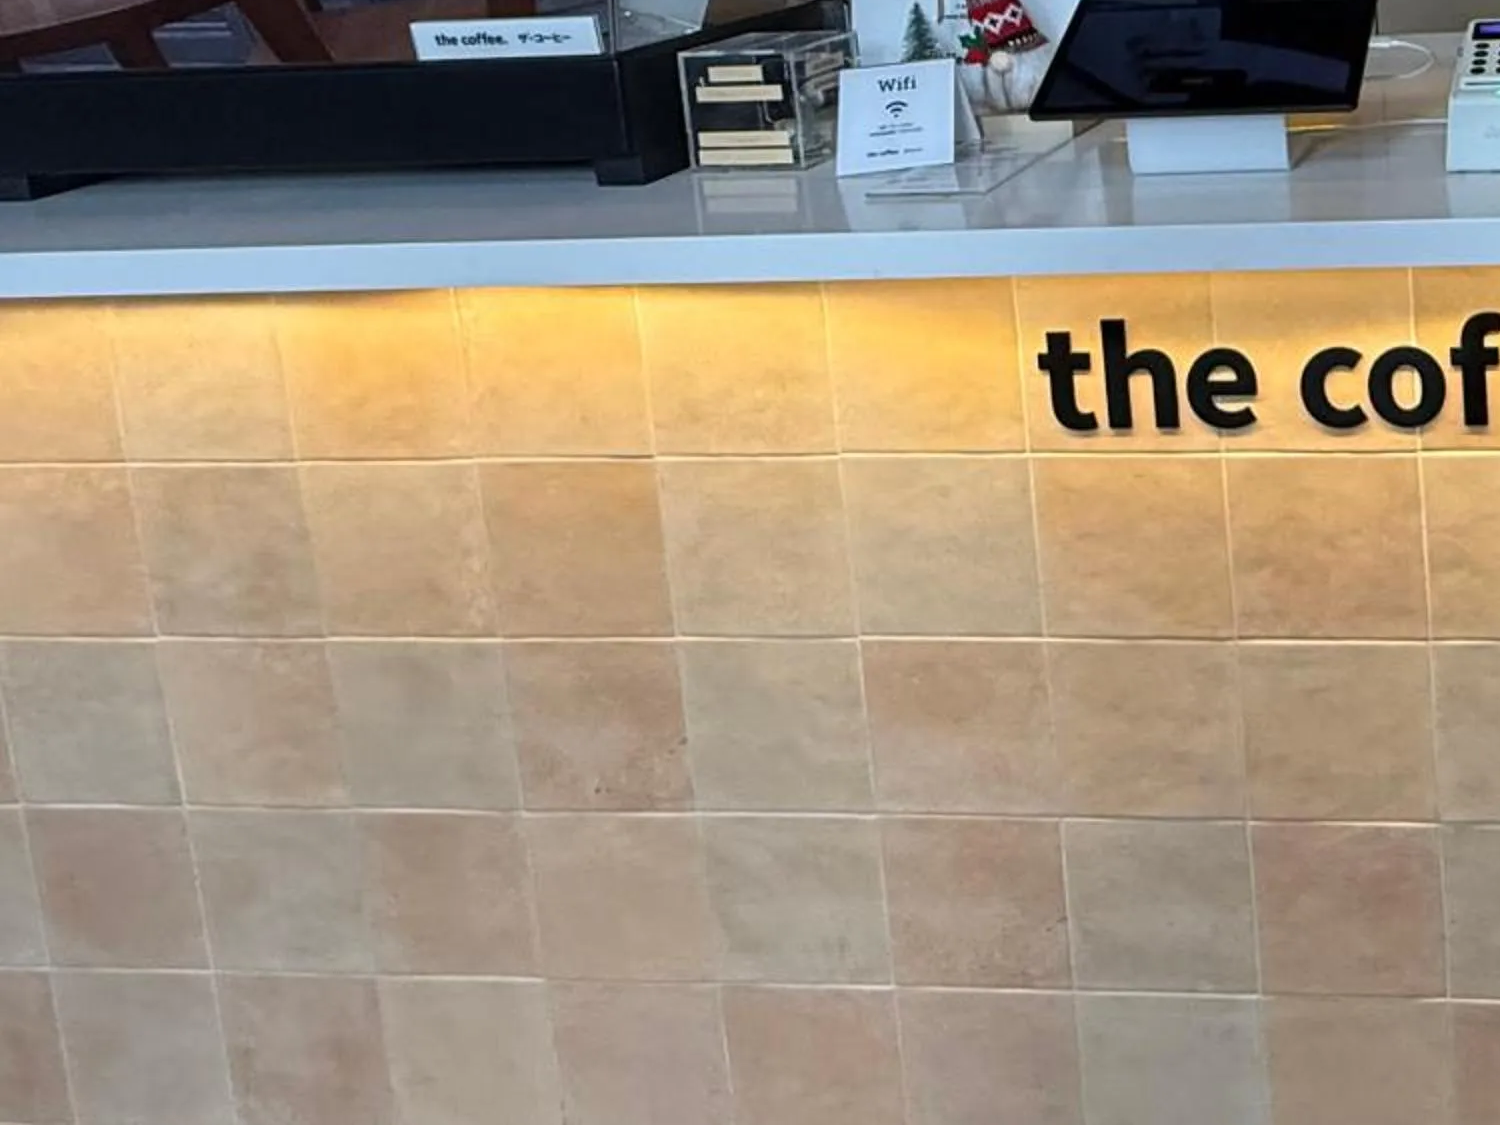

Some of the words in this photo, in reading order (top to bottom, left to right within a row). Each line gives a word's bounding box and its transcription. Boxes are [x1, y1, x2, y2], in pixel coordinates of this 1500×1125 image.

[434, 32, 458, 47] the
[460, 31, 509, 46] coffee.
[877, 75, 917, 92] Wifi
[1037, 319, 1258, 432] the
